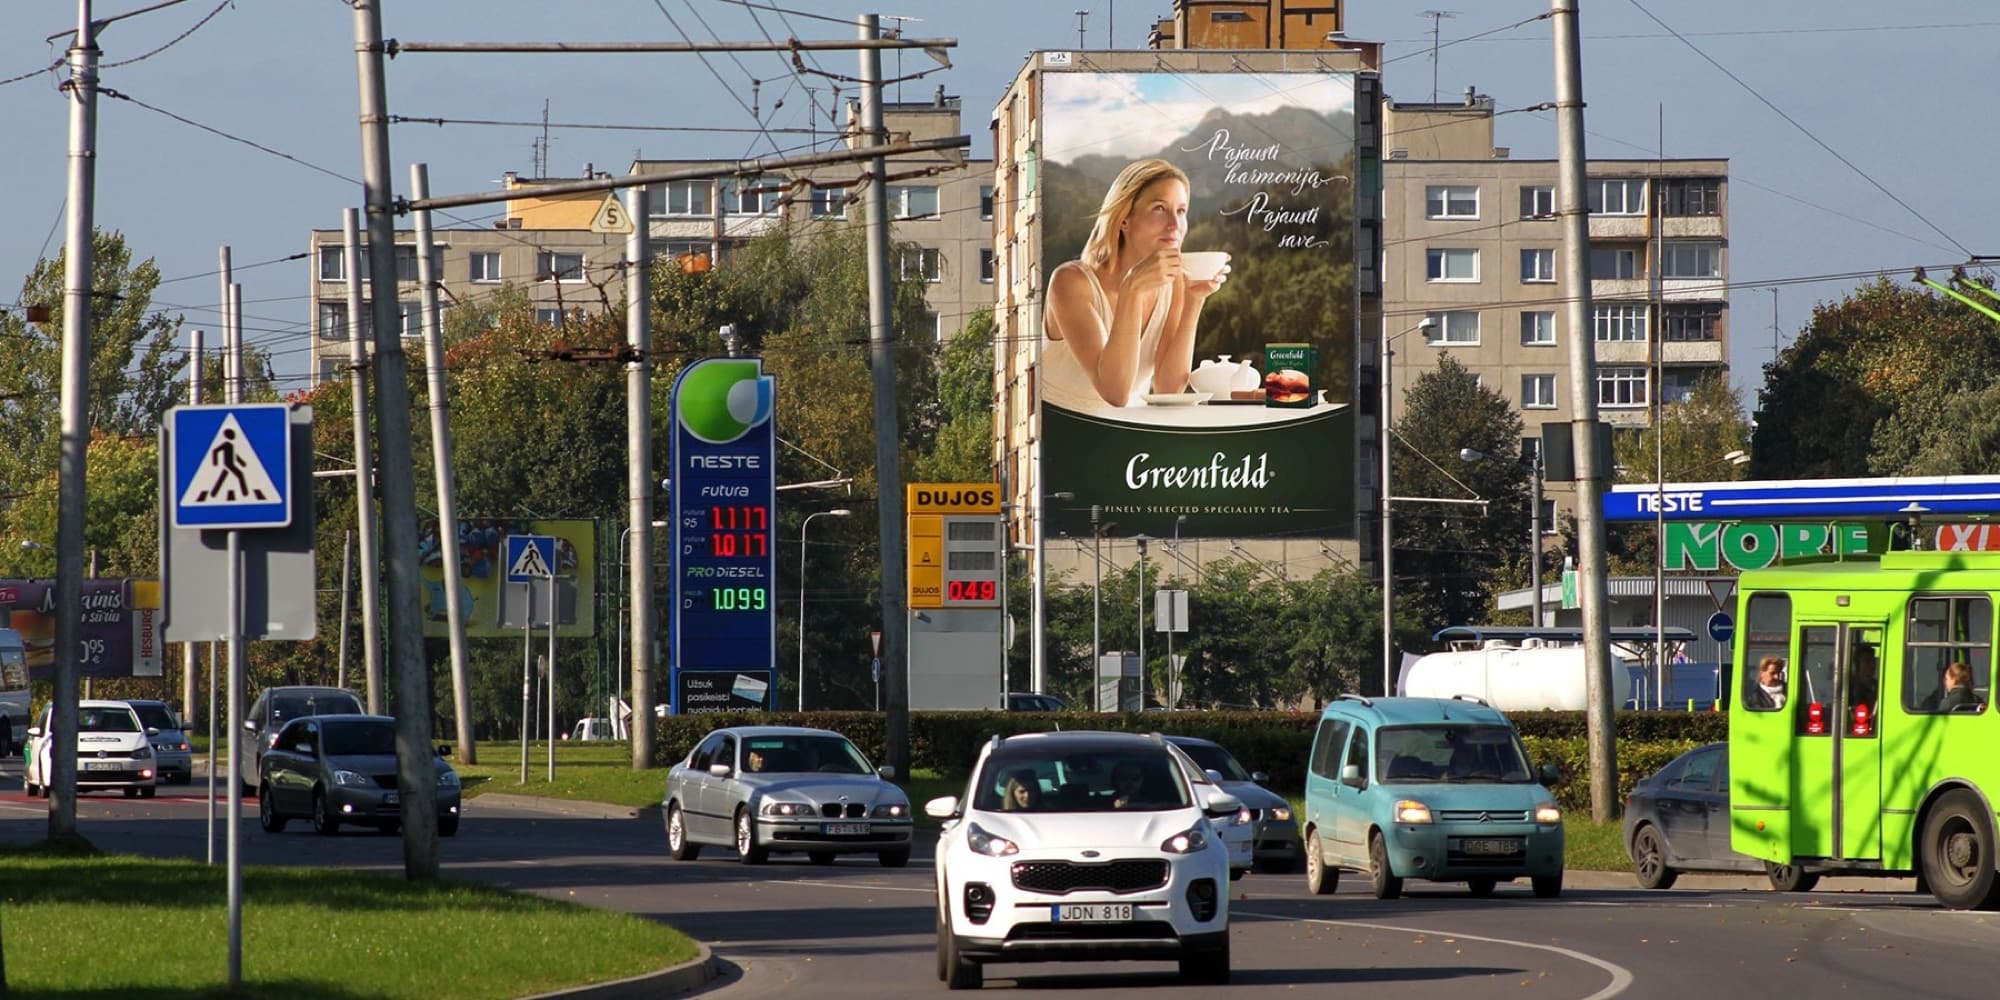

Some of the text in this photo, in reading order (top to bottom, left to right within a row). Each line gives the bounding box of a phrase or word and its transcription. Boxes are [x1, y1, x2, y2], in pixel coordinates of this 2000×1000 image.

[1181, 128, 1281, 168] Pajausti
[1219, 191, 1320, 232] Pajausti
[1270, 350, 1304, 360] Greenfield
[690, 455, 760, 468] NESTE
[1125, 451, 1271, 490] Greenfield
[701, 484, 750, 497] Futura
[917, 490, 994, 506] DUJOS
[1637, 493, 1703, 512] NESTE
[1105, 505, 1290, 514] FINELY SELECTED SPECIALITY TEA
[683, 518, 698, 528] 95
[684, 545, 693, 555] D
[912, 586, 940, 594] DUJOS
[684, 599, 693, 609] D
[712, 588, 765, 610] 1.099
[1062, 905, 1130, 919] JDN 818
